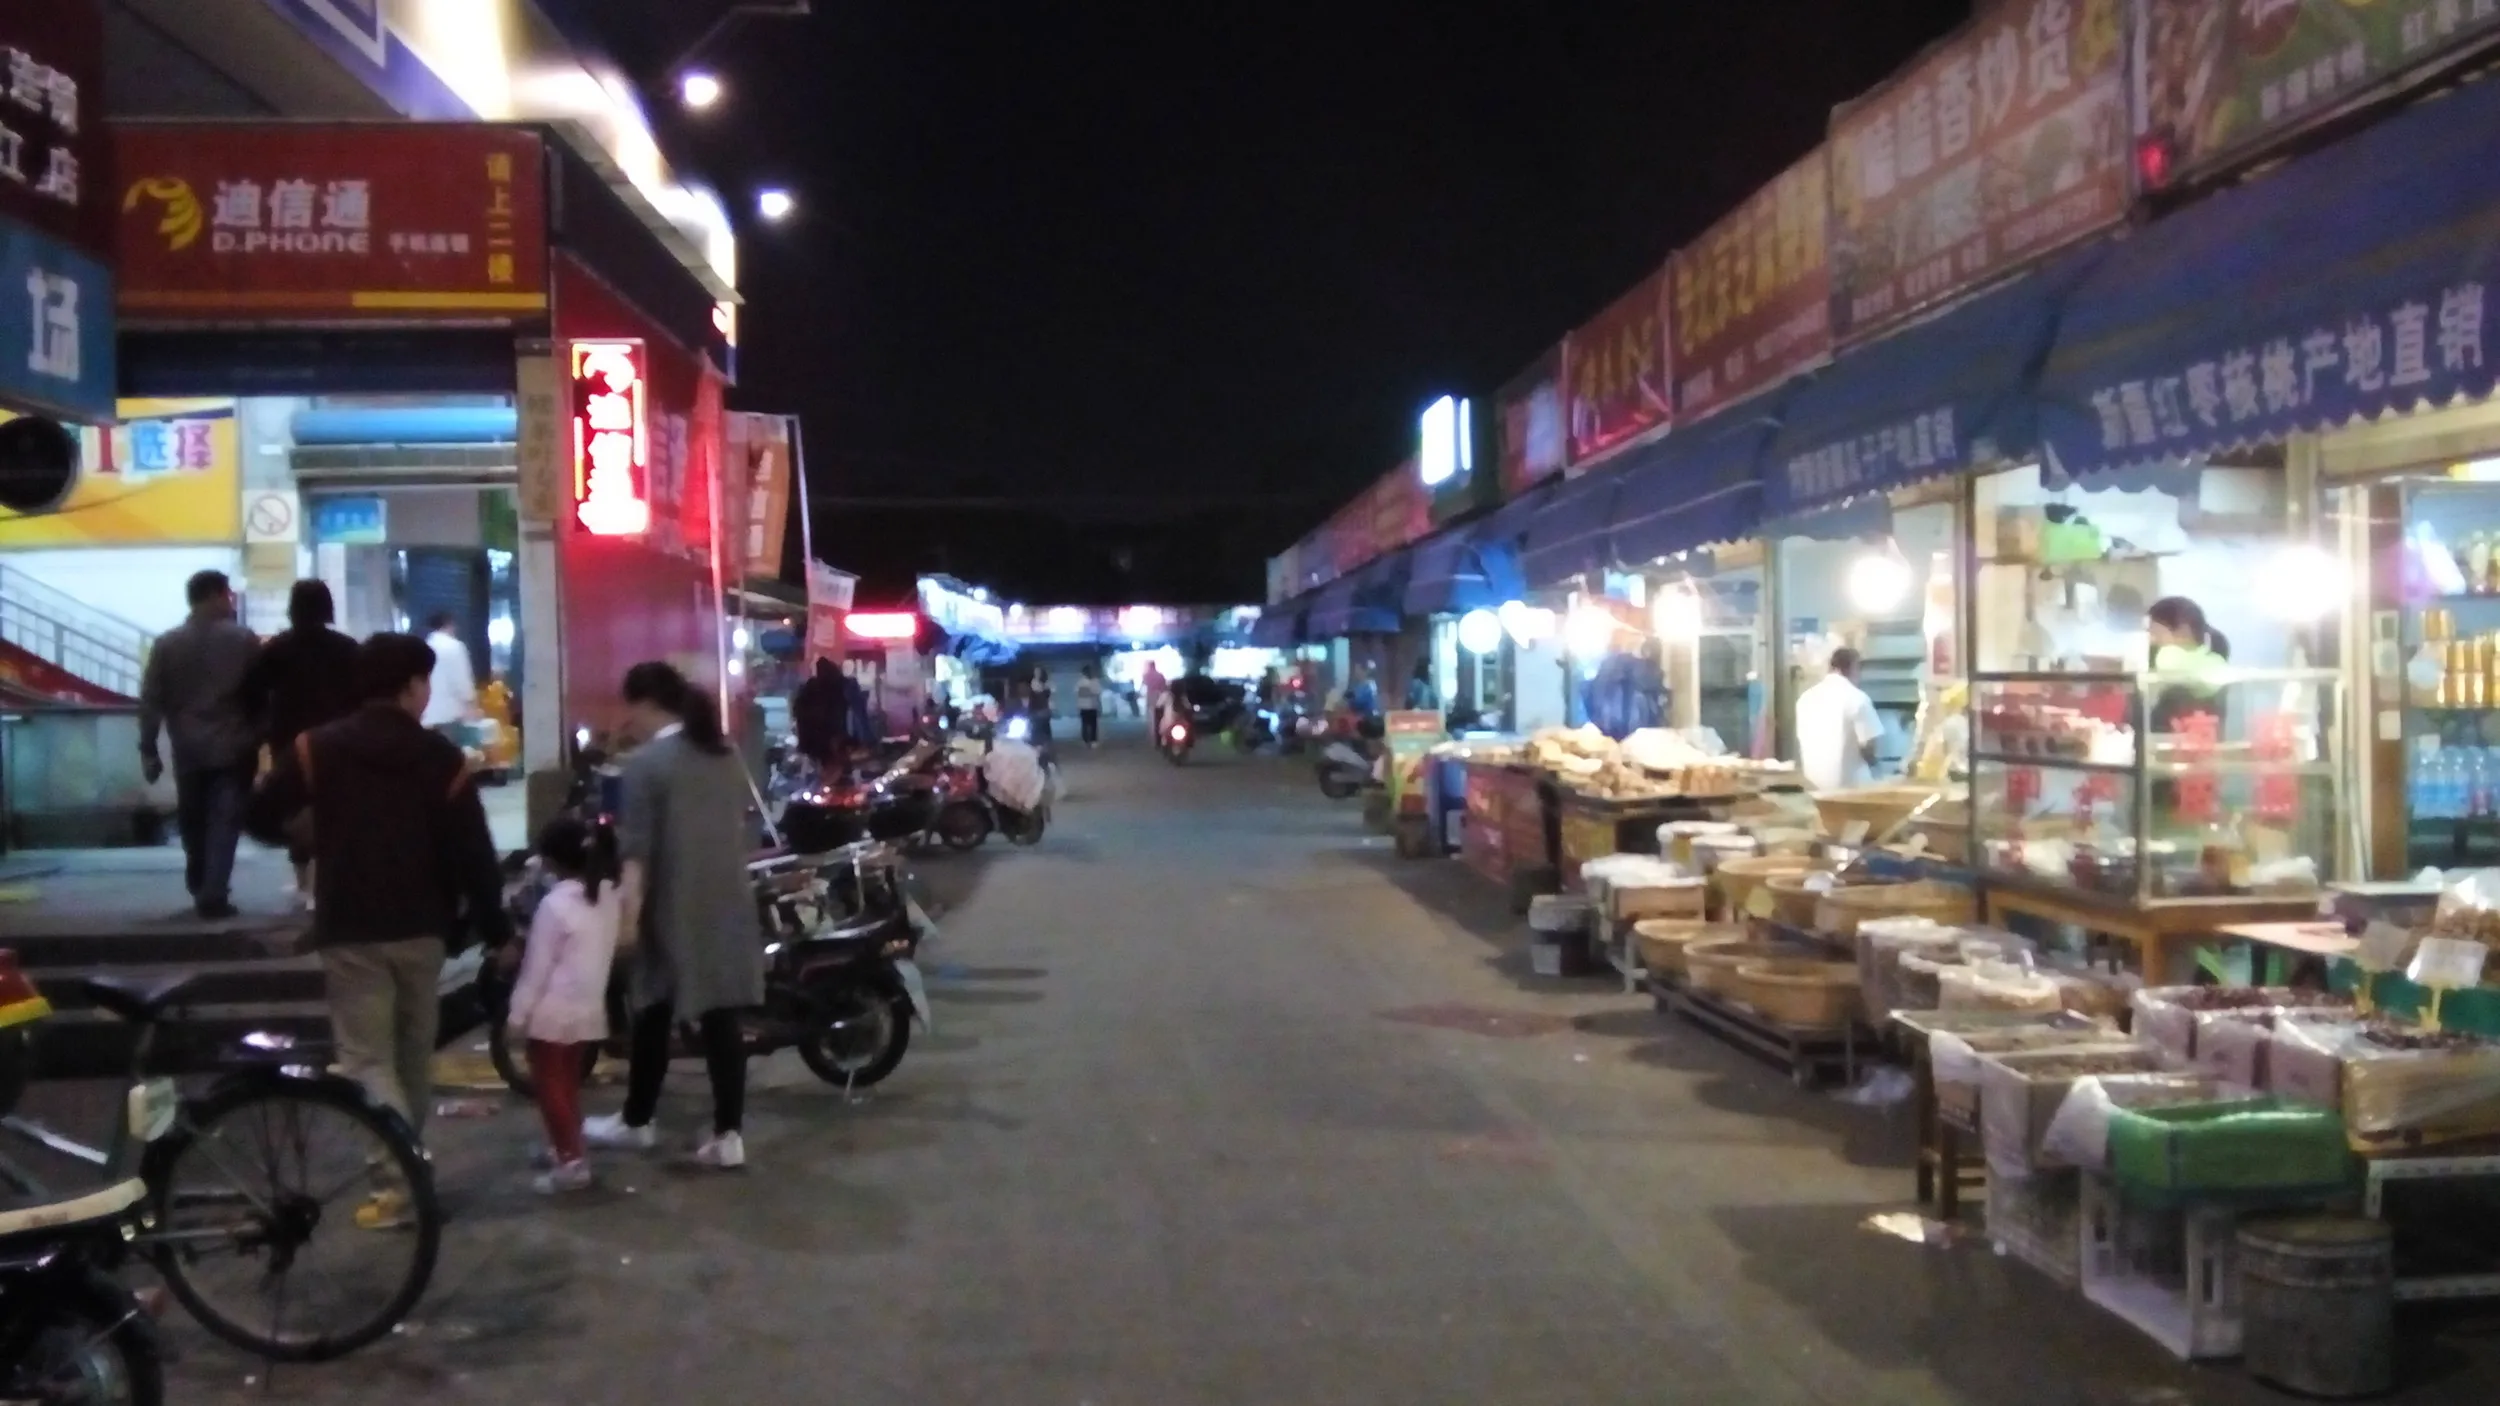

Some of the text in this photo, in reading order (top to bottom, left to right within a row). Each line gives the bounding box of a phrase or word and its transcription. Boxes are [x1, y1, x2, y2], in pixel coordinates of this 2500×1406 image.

[213, 178, 370, 229] 迪信通
[212, 231, 370, 253] D.PHONE
